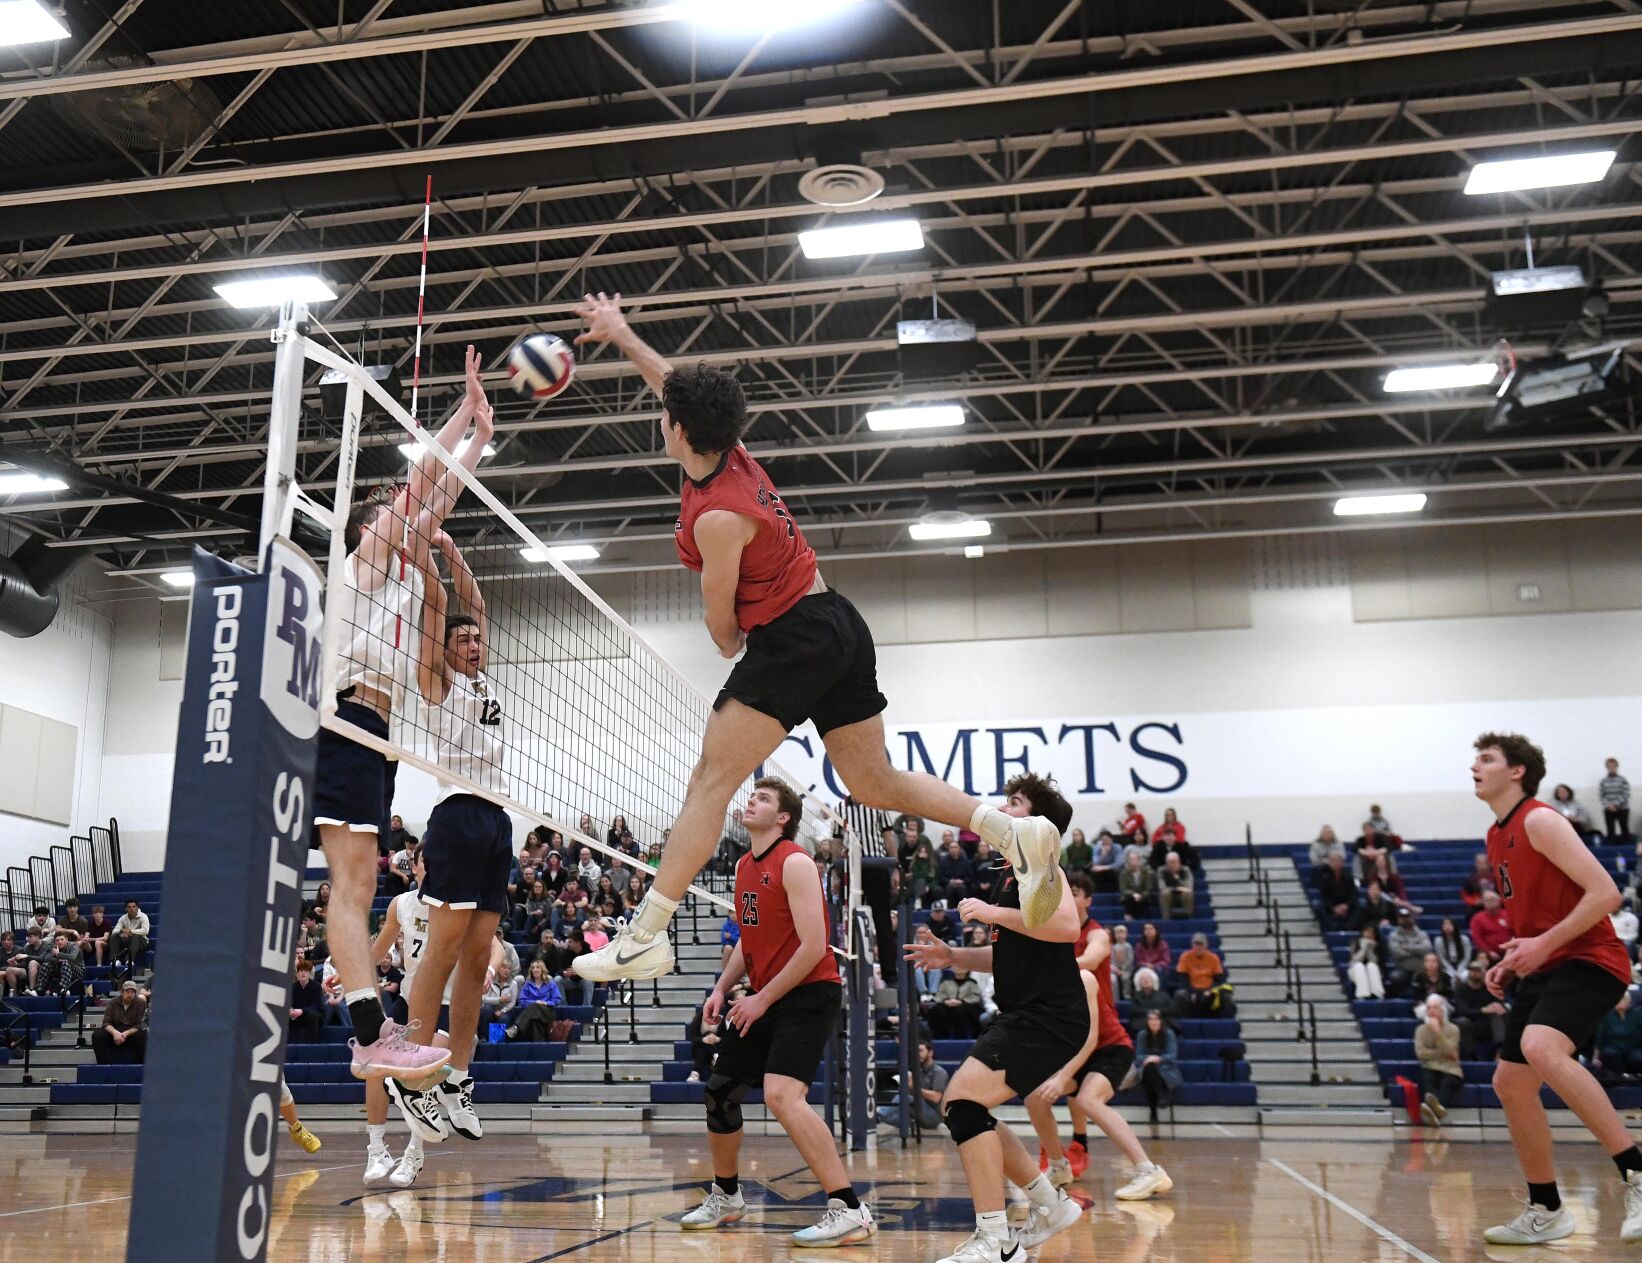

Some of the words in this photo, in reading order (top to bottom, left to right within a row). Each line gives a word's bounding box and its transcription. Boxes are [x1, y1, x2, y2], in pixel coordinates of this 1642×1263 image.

[480, 699, 501, 725] 12
[742, 892, 759, 926] 25
[412, 938, 422, 958] 7
[237, 771, 304, 1260] COMETS
